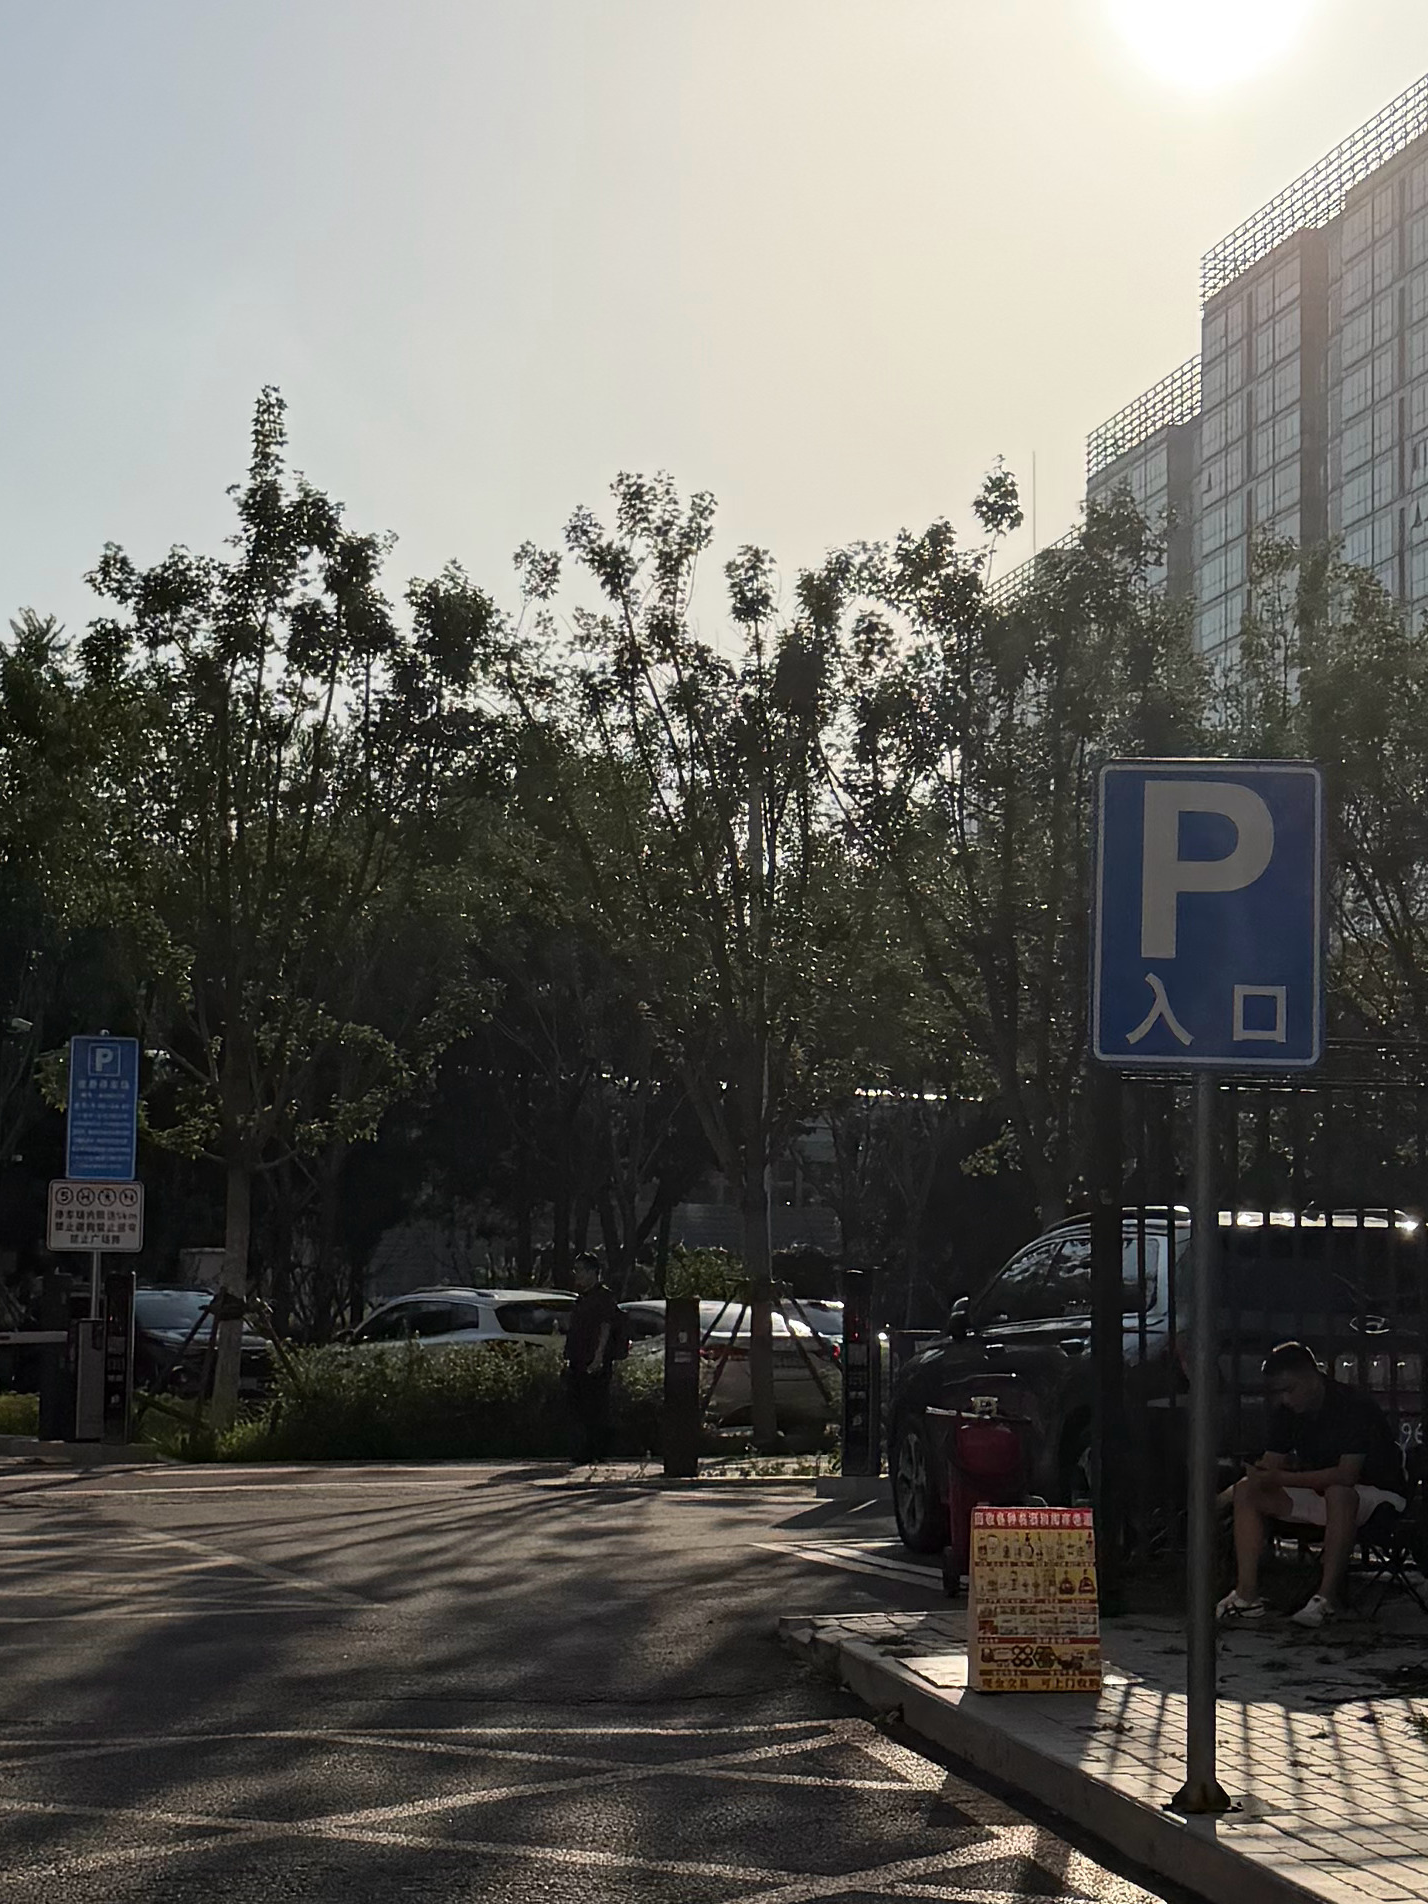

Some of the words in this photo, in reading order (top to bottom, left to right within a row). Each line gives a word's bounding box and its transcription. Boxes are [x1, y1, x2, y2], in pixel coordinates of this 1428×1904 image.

[1141, 780, 1275, 959] P
[1125, 973, 1287, 1046] 入口
[95, 1048, 114, 1072] P
